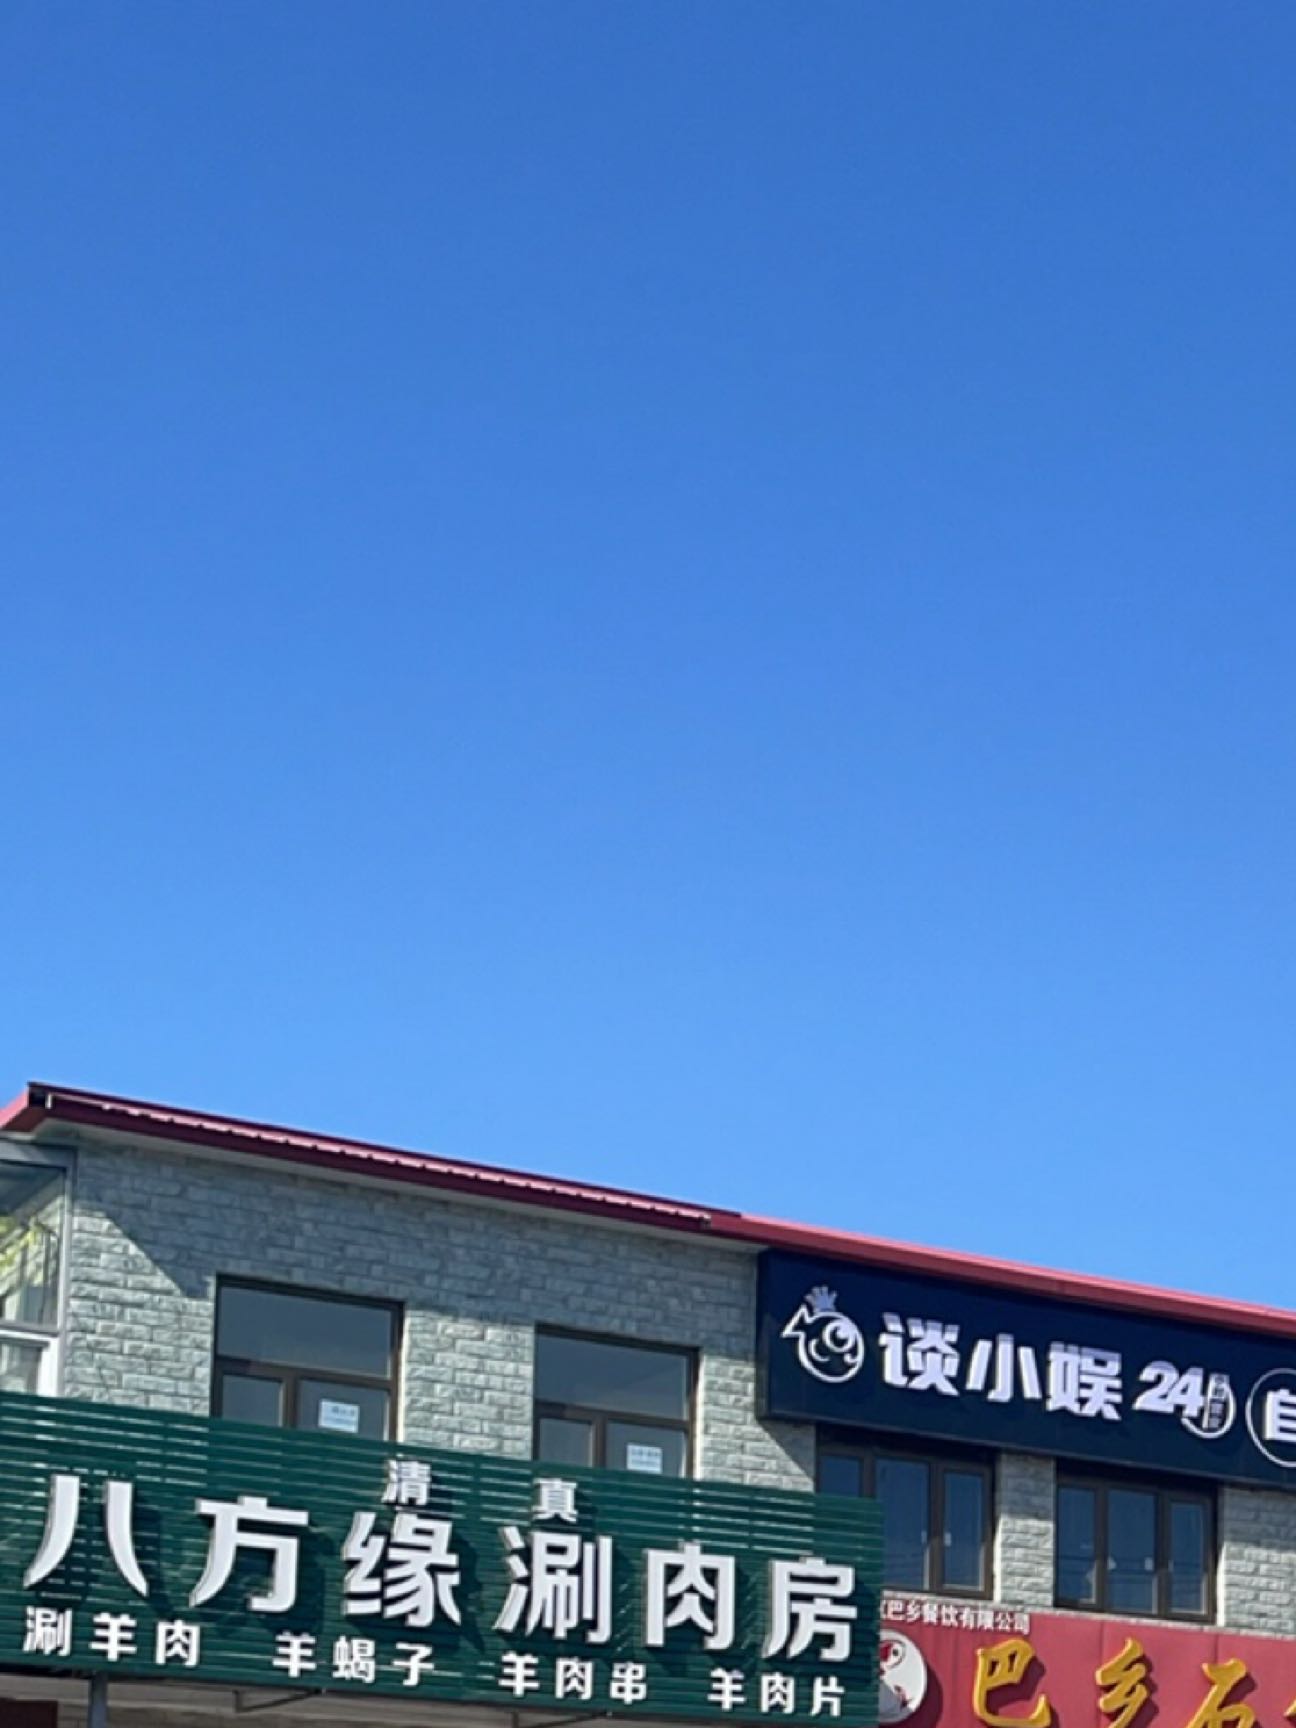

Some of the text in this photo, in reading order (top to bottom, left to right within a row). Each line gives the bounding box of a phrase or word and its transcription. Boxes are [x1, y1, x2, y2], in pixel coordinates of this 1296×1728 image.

[879, 1313, 1123, 1421] 谈小娱
[380, 1457, 580, 1525] 清真
[22, 1474, 860, 1664] 八方缘涮肉房
[880, 1599, 1031, 1635] 巴乡餐饮有限公司
[22, 1605, 847, 1718] 涮羊肉 羊蝎子 羊肉串 羊肉片
